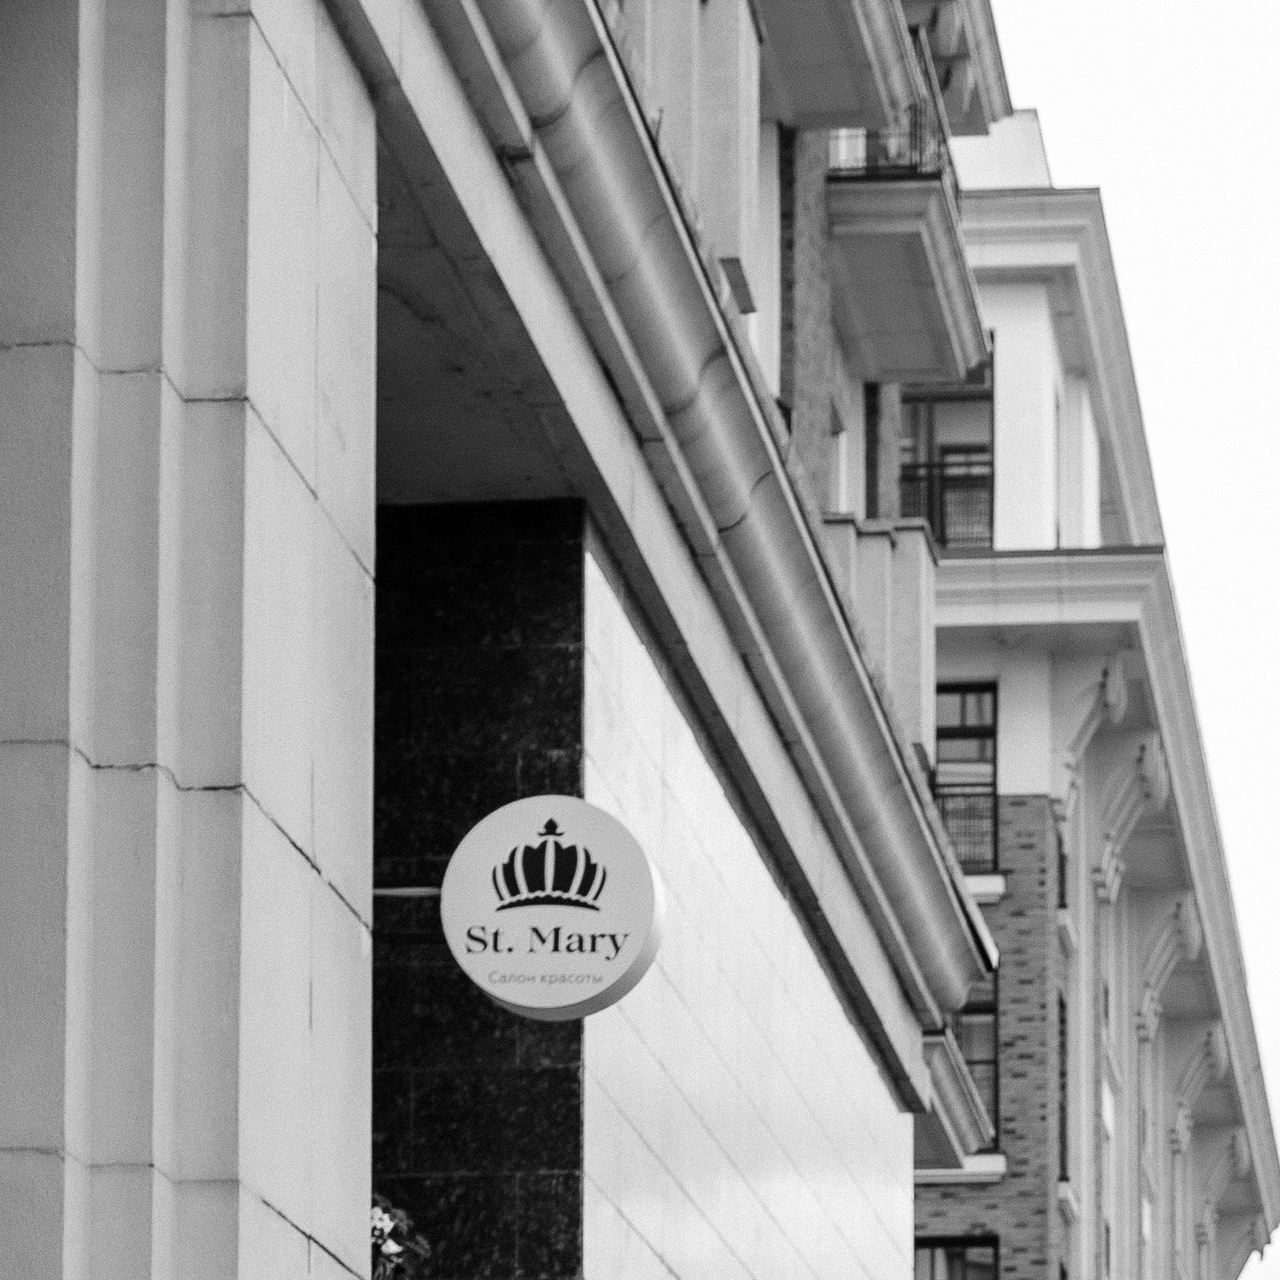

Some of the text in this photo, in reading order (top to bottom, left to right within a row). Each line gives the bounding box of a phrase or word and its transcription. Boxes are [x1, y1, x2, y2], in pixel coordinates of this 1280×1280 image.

[465, 925, 629, 961] St. Mary
[488, 970, 536, 985] Салон
